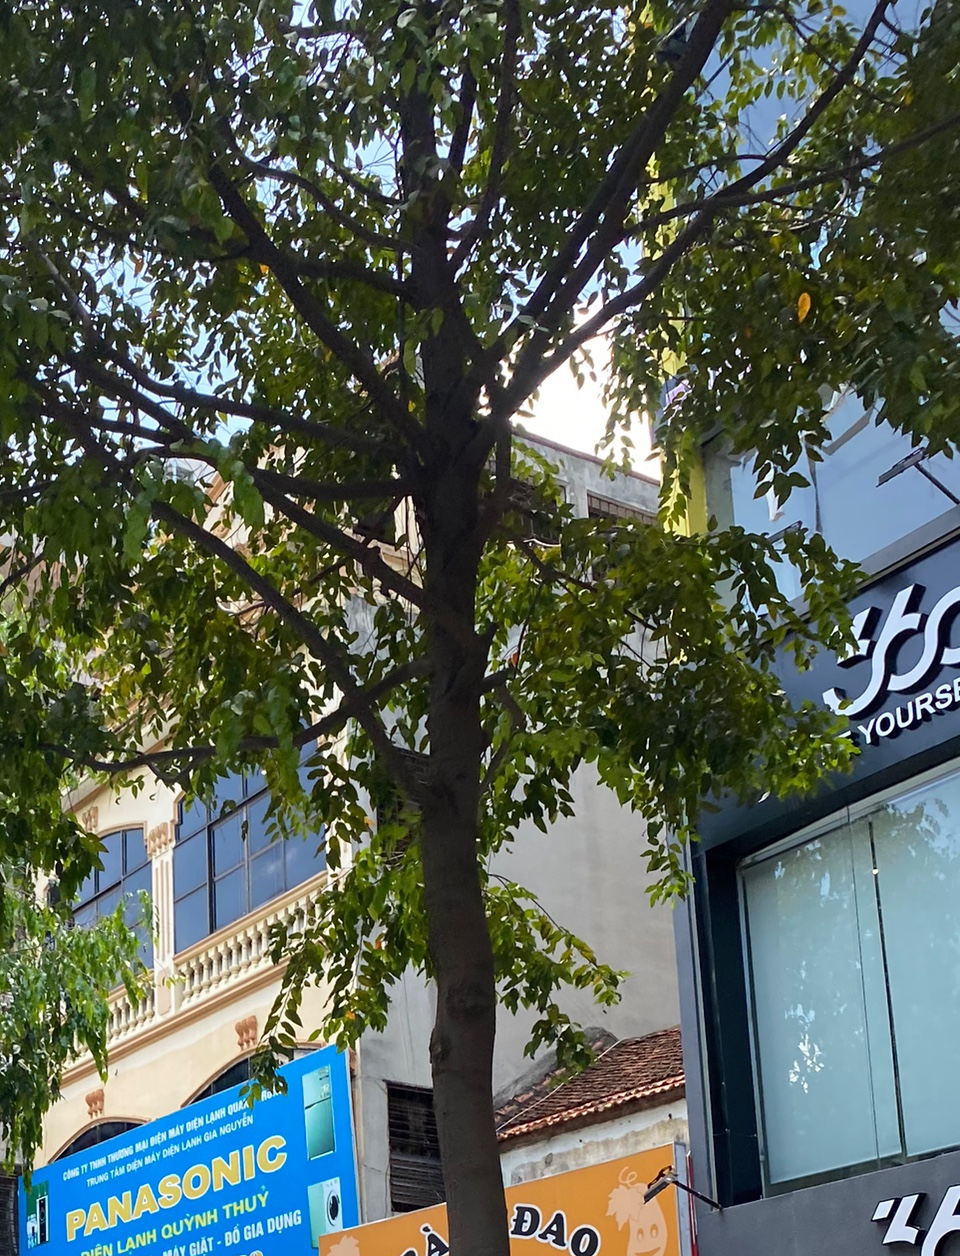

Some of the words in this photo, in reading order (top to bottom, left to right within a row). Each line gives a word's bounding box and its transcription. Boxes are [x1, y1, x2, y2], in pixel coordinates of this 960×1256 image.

[168, 1122, 185, 1139] MÁY
[205, 1107, 226, 1125] LẠNH
[86, 1172, 109, 1188] TRUNG
[144, 1150, 161, 1166] MÁY
[181, 1134, 202, 1153] LẠNH
[203, 1129, 218, 1143] GIA
[66, 1134, 288, 1243] PANASONIC
[116, 1230, 158, 1254] LẠNH
[161, 1211, 218, 1240] QUỲNH
[243, 1222, 264, 1240] GIA
[267, 1208, 302, 1237] DỤNG
